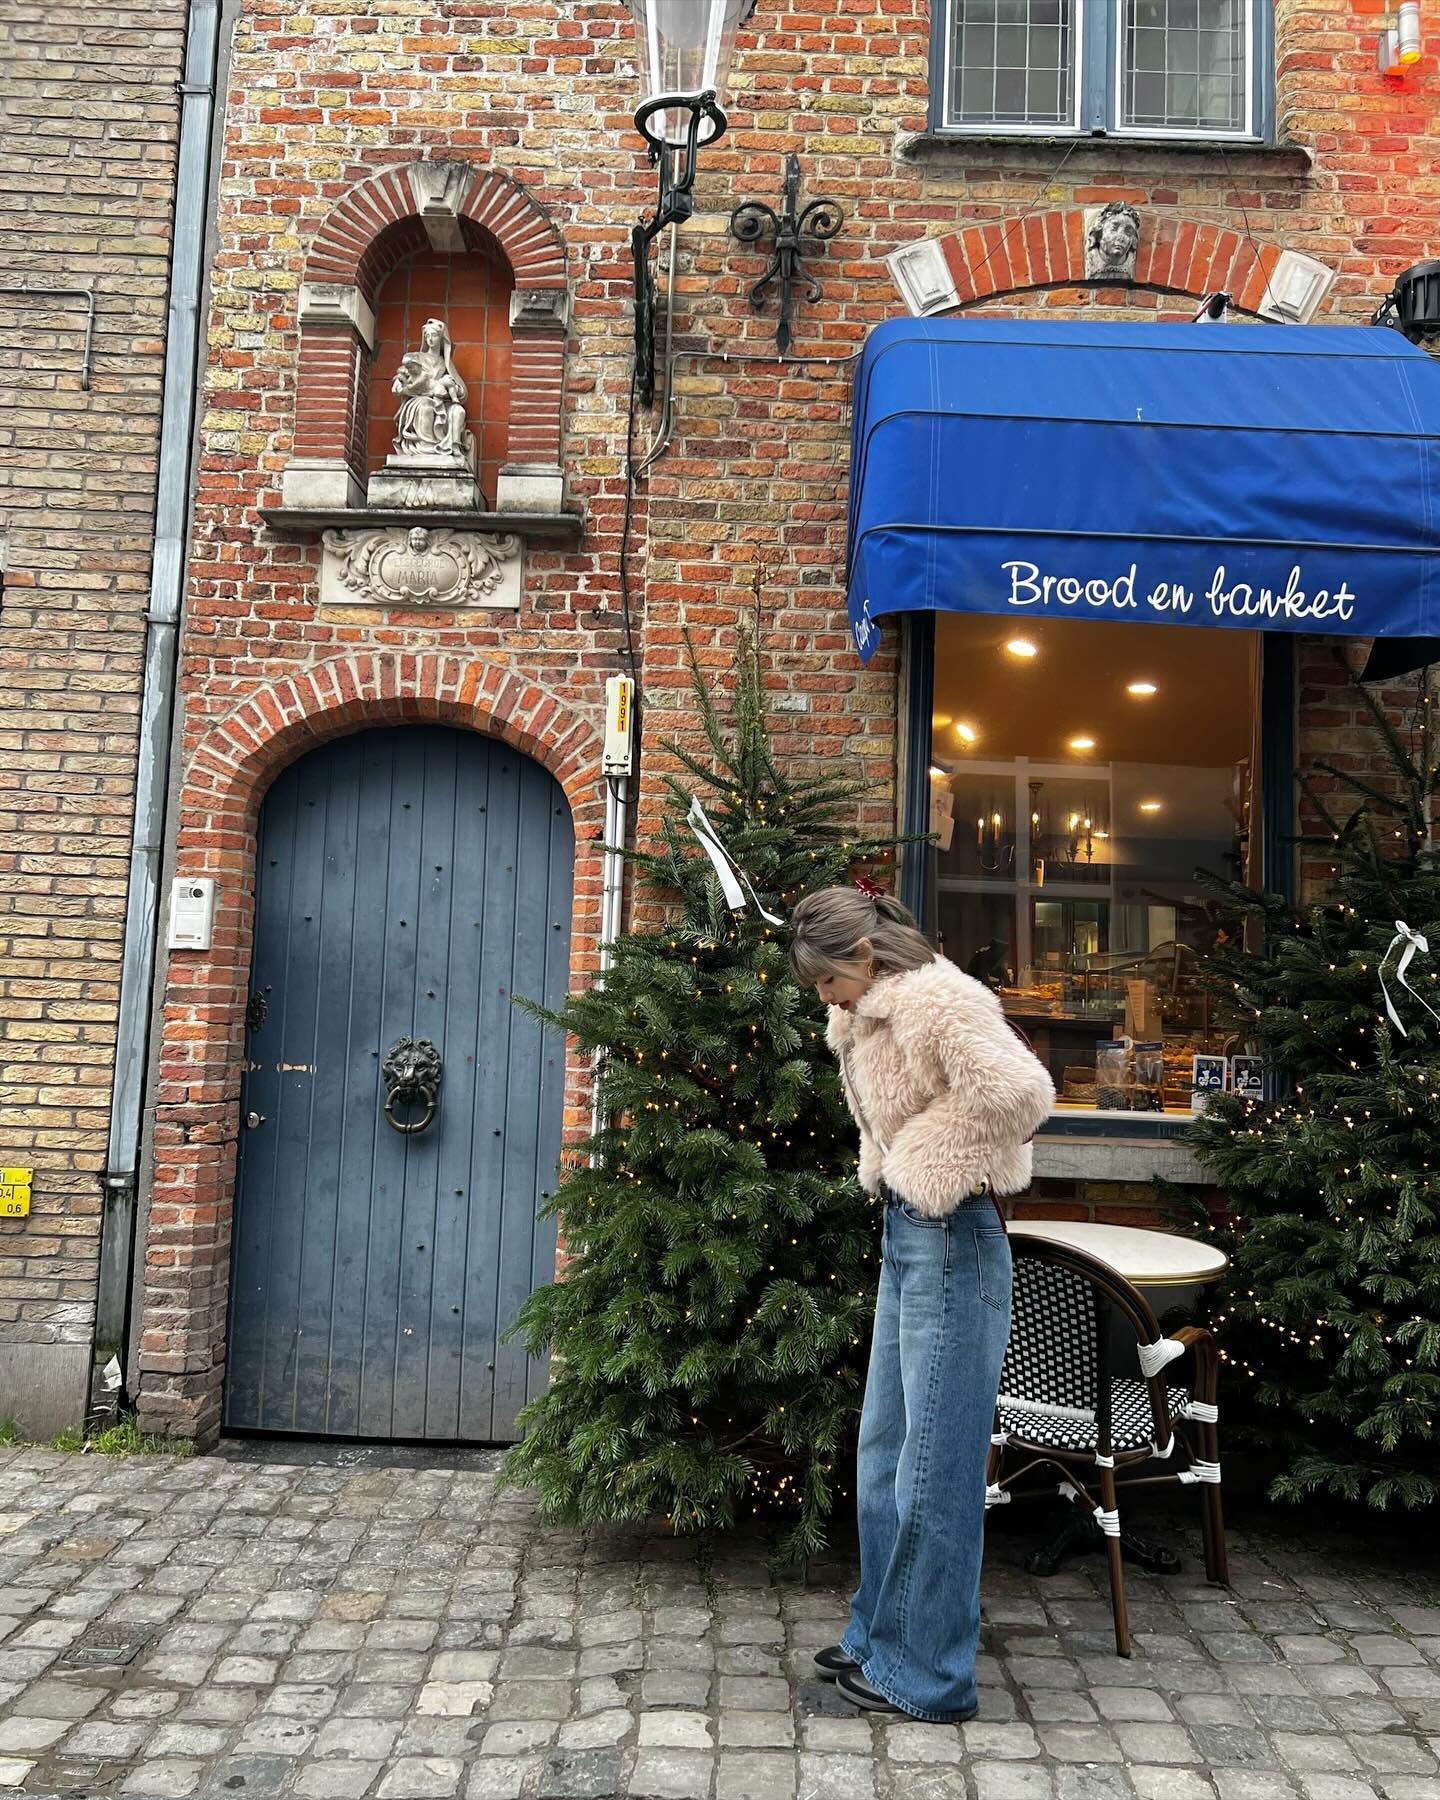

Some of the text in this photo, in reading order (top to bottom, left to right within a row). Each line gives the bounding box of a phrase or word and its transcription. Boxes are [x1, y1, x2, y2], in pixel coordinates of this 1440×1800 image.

[397, 570, 439, 585] MARIA
[1001, 561, 1355, 620] Brood en banket
[7, 1204, 21, 1214] 0,6
